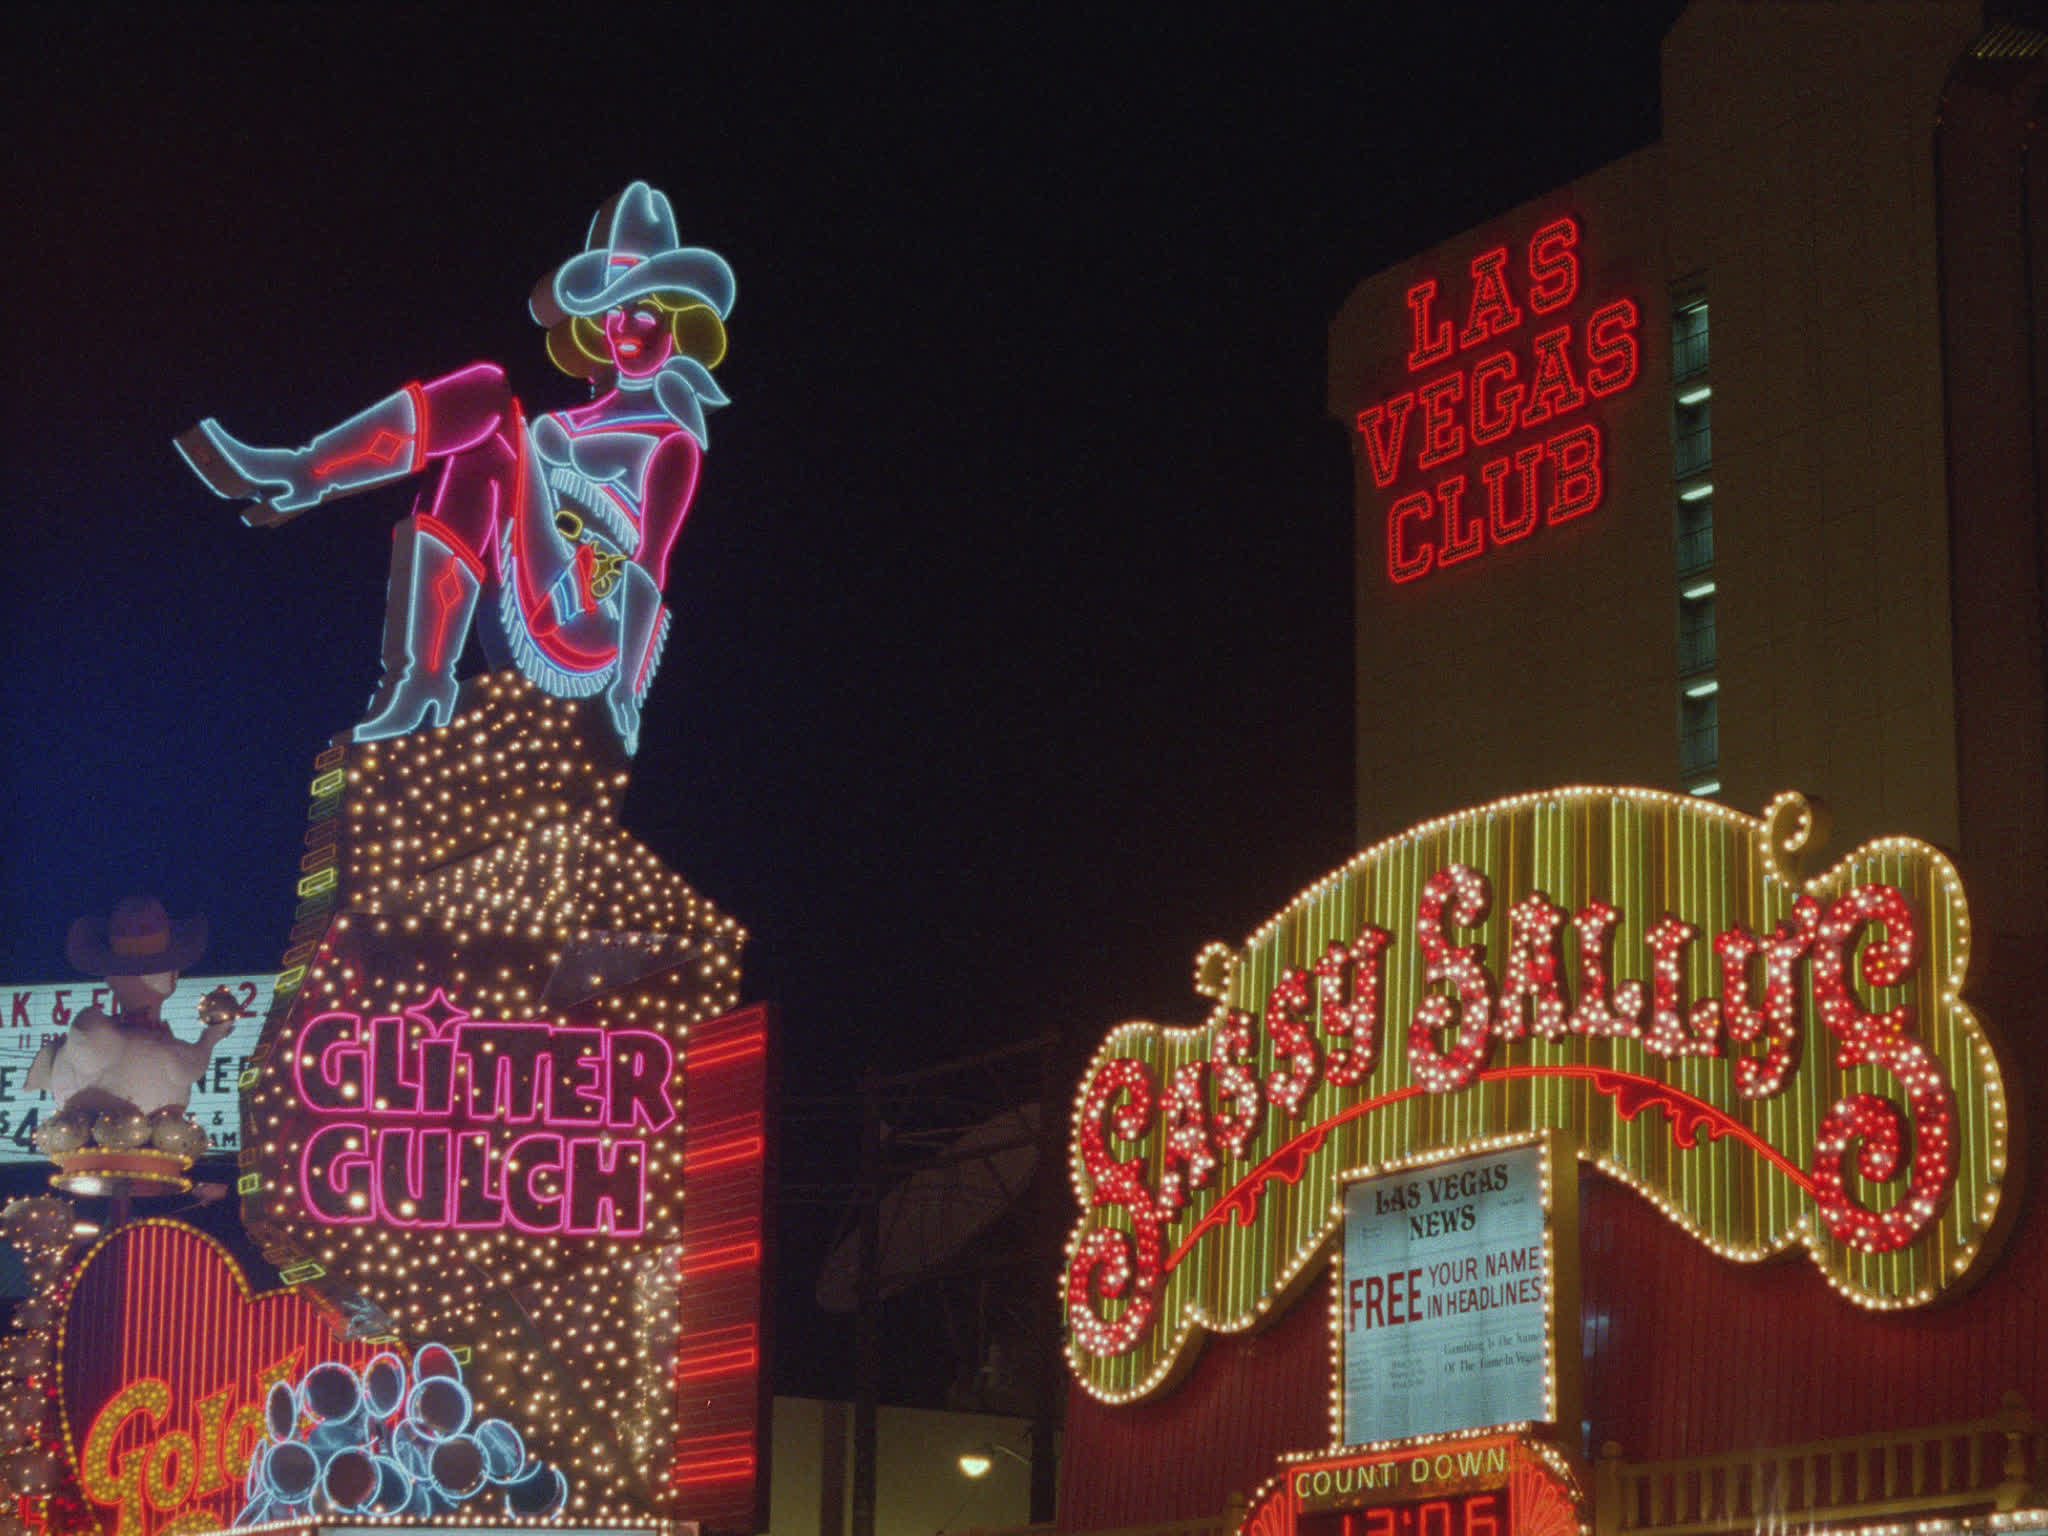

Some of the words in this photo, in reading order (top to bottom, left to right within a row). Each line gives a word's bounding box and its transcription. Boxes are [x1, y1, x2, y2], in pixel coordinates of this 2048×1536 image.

[1407, 217, 1577, 371] LAS
[1357, 299, 1638, 488] VEGAS
[1388, 424, 1602, 583] CLUB
[295, 986, 677, 1132] GLITTER
[302, 1123, 647, 1237] GULCH
[1375, 1181, 1421, 1216] LAS
[1427, 1163, 1508, 1204] VEGAS
[1409, 1204, 1476, 1241] NEWS
[1427, 1292, 1443, 1320] IN
[1447, 1277, 1542, 1316] HEADLINES
[1428, 1257, 1478, 1288] YOUR
[1485, 1246, 1540, 1278] NAME
[1349, 1268, 1423, 1333] FREE
[1296, 1461, 1395, 1498] COUNT
[1412, 1447, 1506, 1483] DOWN
